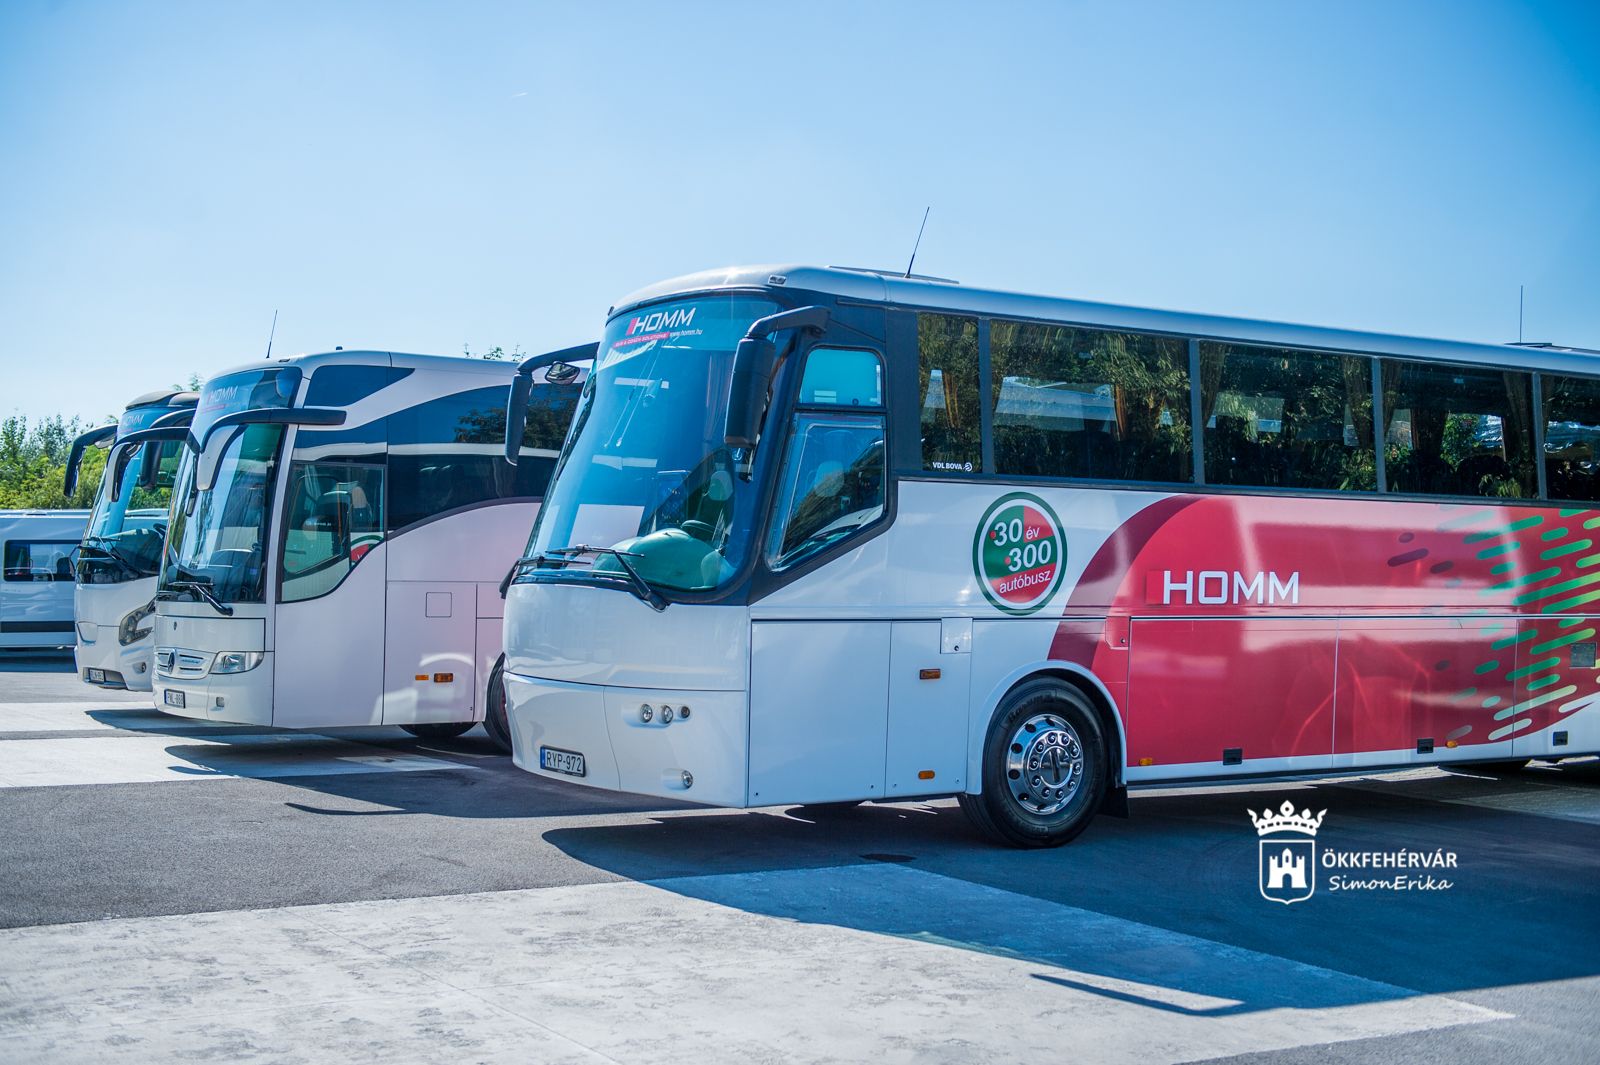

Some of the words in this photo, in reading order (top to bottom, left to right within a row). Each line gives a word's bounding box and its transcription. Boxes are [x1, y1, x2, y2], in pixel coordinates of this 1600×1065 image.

[631, 307, 696, 334] HOMM
[932, 461, 945, 469] VDL
[946, 462, 963, 470] BOVA
[993, 518, 1023, 547] 30
[1025, 526, 1040, 540] év
[1007, 540, 1052, 572] 300
[999, 570, 1051, 594] autóbusz
[1163, 570, 1299, 605] HOMM
[546, 751, 582, 772] RYP-972
